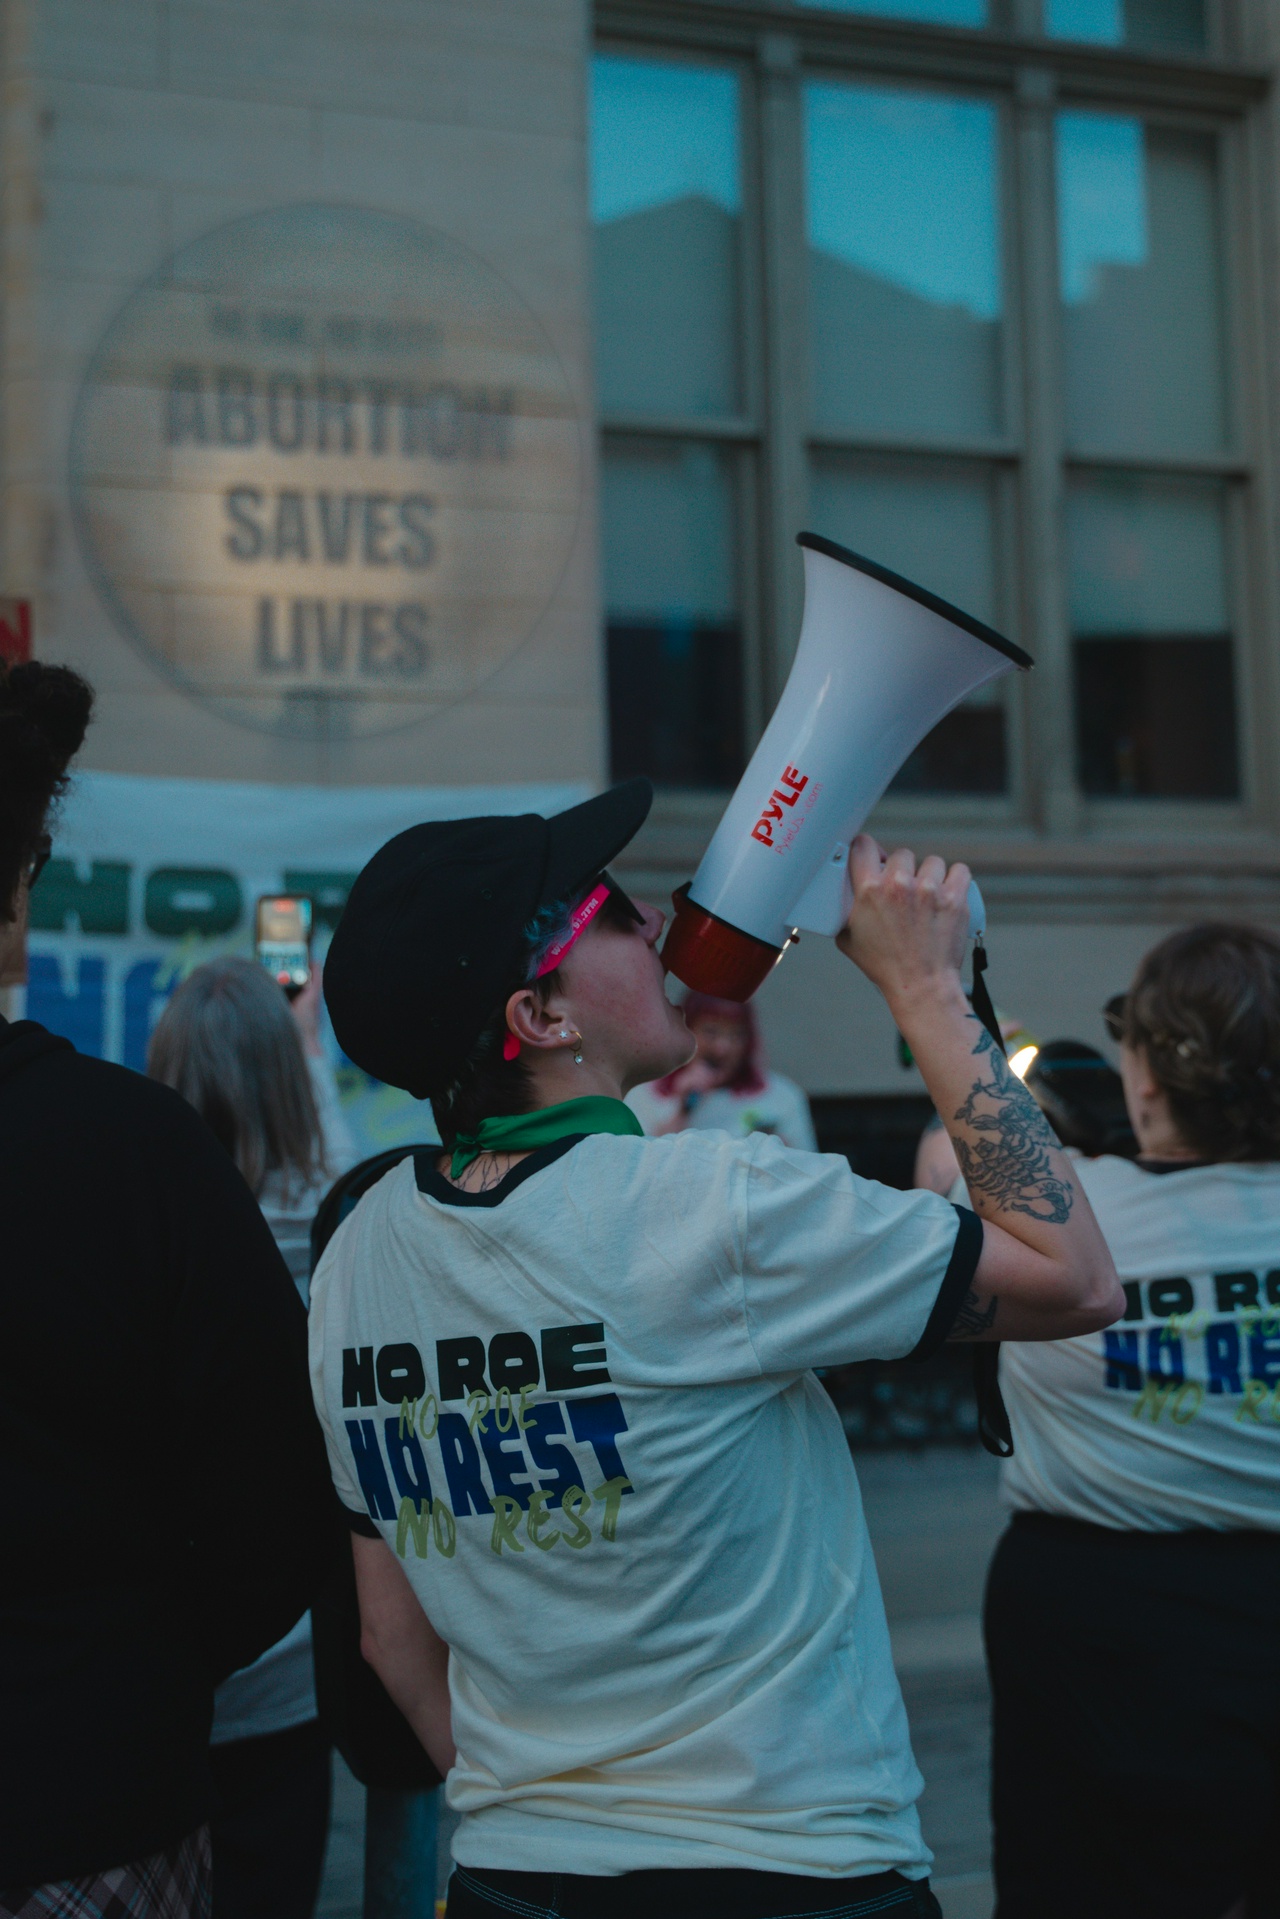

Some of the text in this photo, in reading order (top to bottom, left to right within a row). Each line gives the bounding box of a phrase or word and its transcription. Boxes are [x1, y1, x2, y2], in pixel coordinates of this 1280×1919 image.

[164, 361, 516, 461] ABORTION
[223, 485, 438, 569] SAVES
[257, 597, 432, 678] LIVES
[751, 765, 809, 848] PYLE
[342, 1322, 612, 1408] NO ROE
[1103, 1326, 1185, 1391] NO
[398, 1383, 538, 1441] NO ROE
[1132, 1380, 1205, 1425] NO
[345, 1392, 635, 1521] NO REST
[396, 1476, 634, 1559] NO REST
